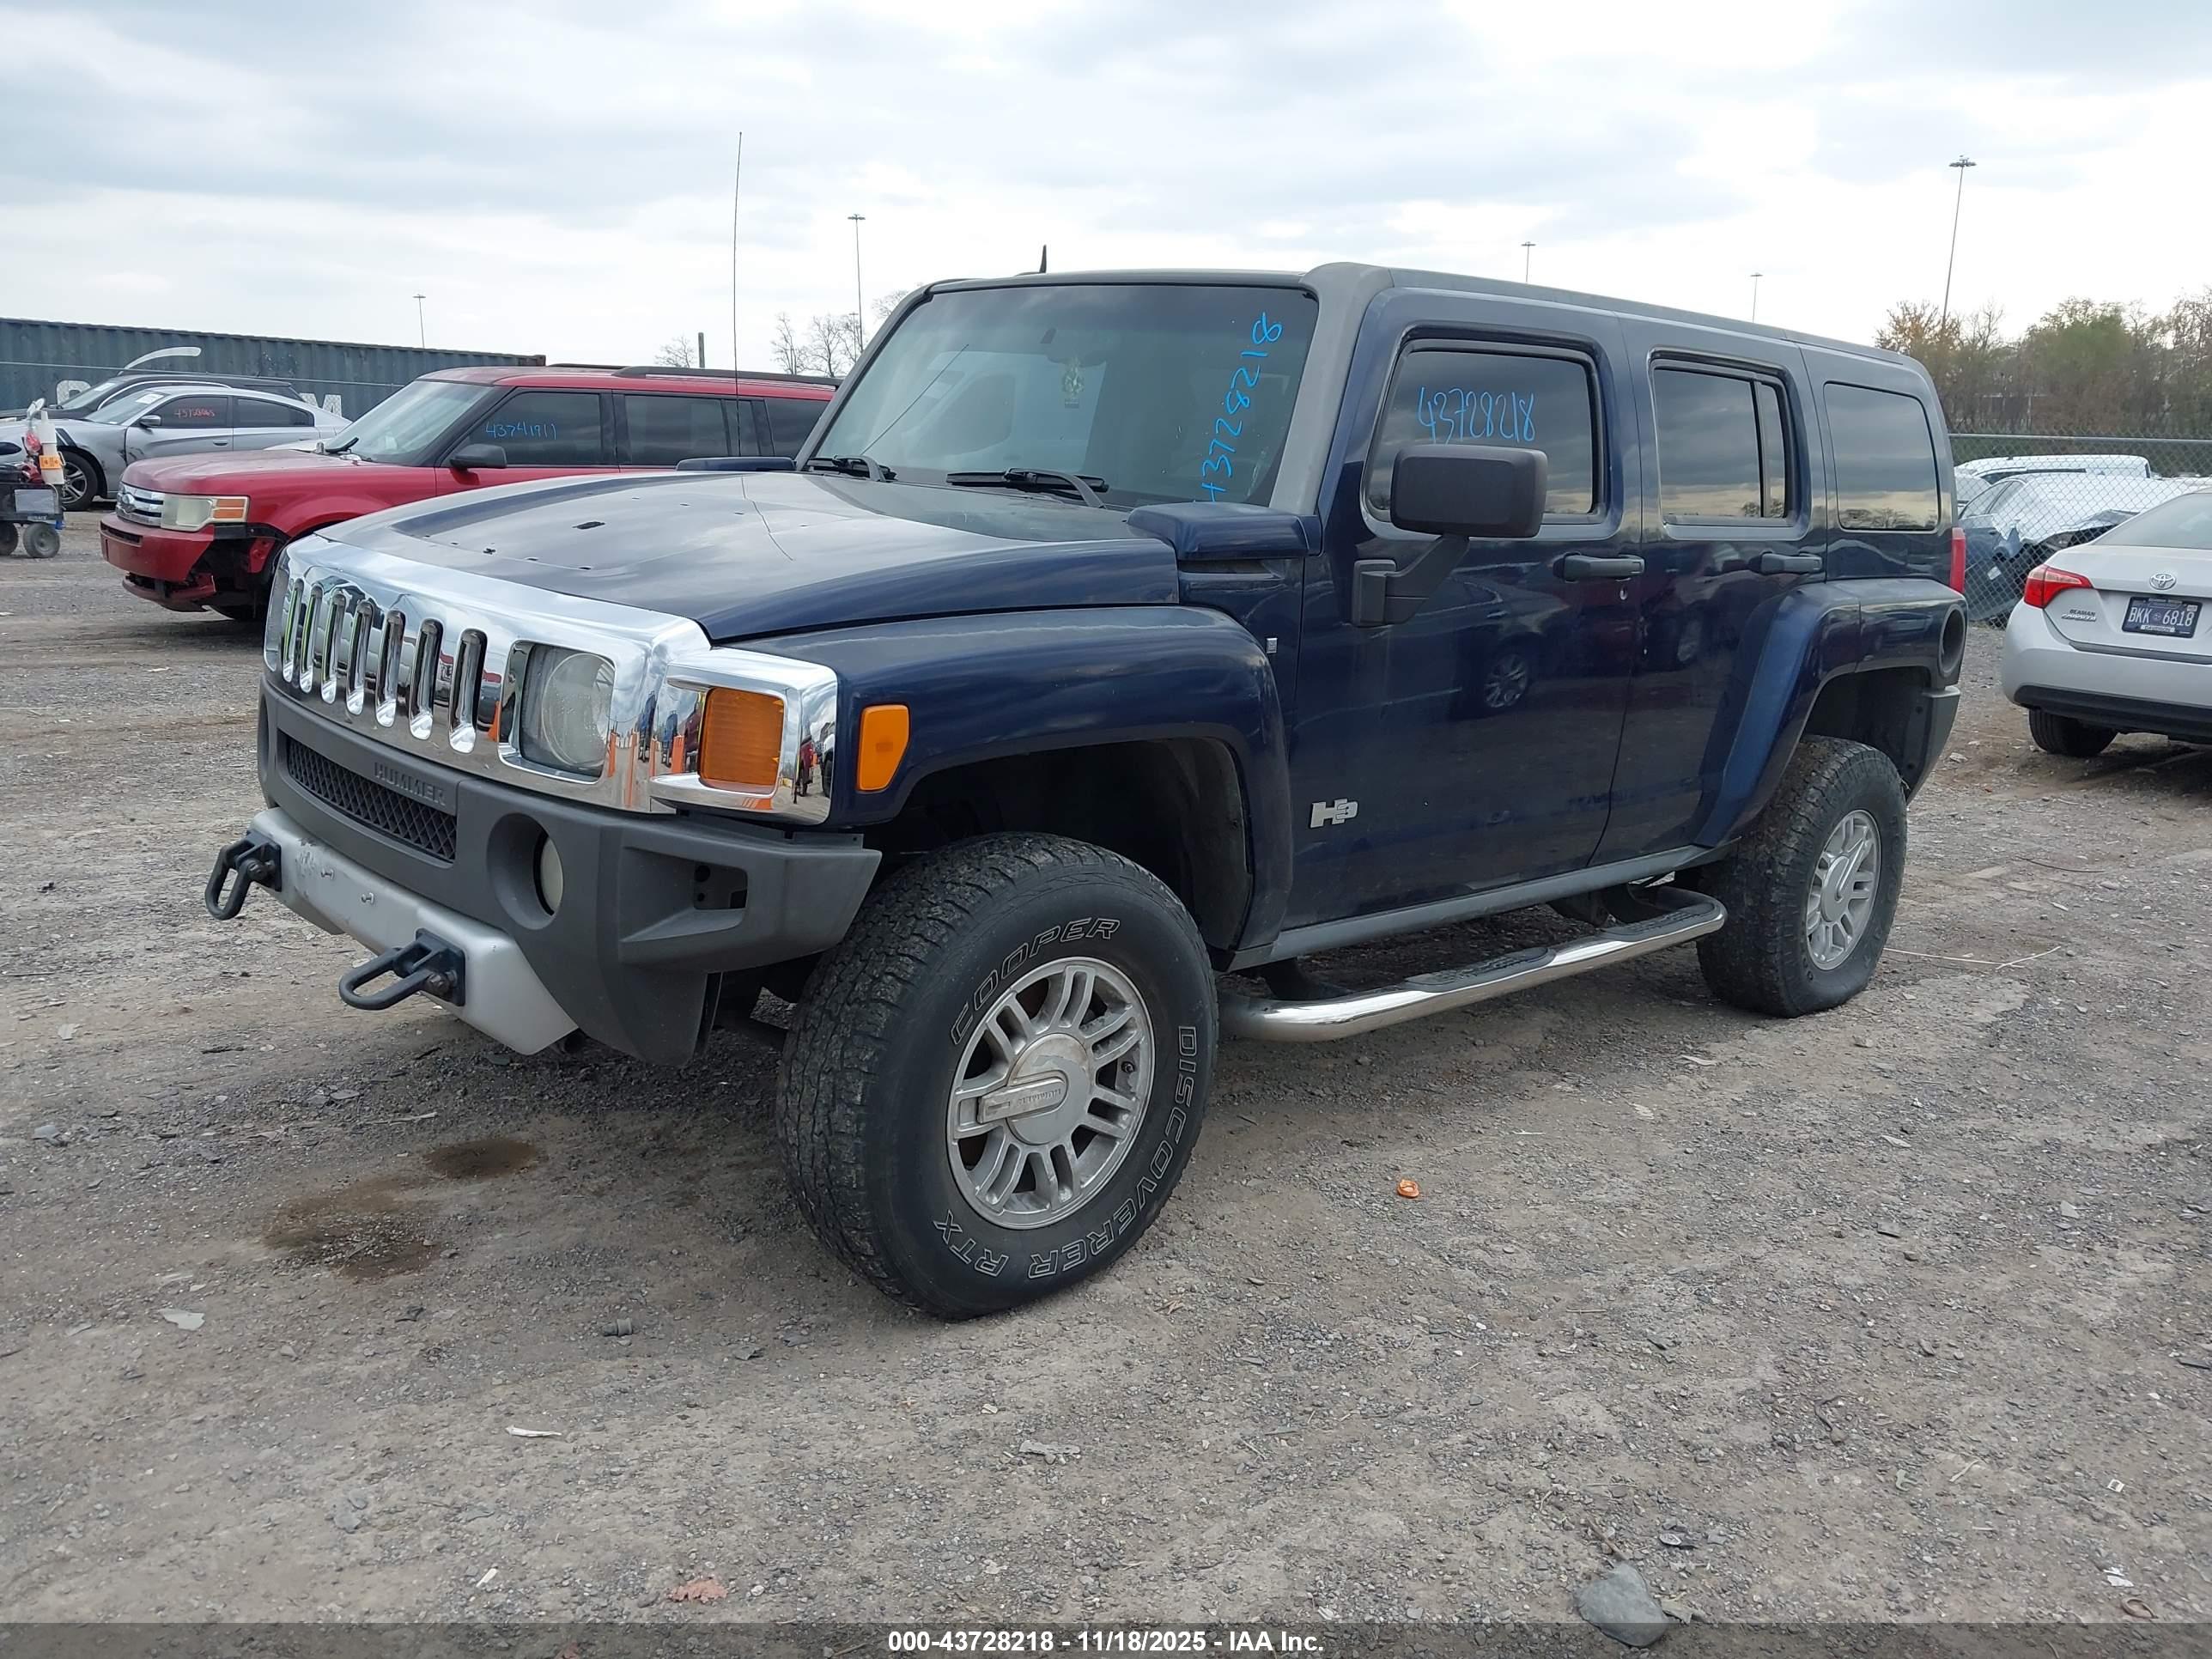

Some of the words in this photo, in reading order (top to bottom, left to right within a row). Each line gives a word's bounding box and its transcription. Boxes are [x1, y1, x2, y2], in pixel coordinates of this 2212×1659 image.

[1419, 386, 1535, 445] 43728218
[2128, 606, 2153, 623] BKK
[2162, 610, 2195, 626] 6818
[374, 762, 446, 805] HUMMER
[1310, 798, 1358, 829] H3
[951, 916, 1121, 1045] COOPER
[1027, 1025, 1198, 1279] DISCOVERER
[933, 1208, 1010, 1278] RTX
